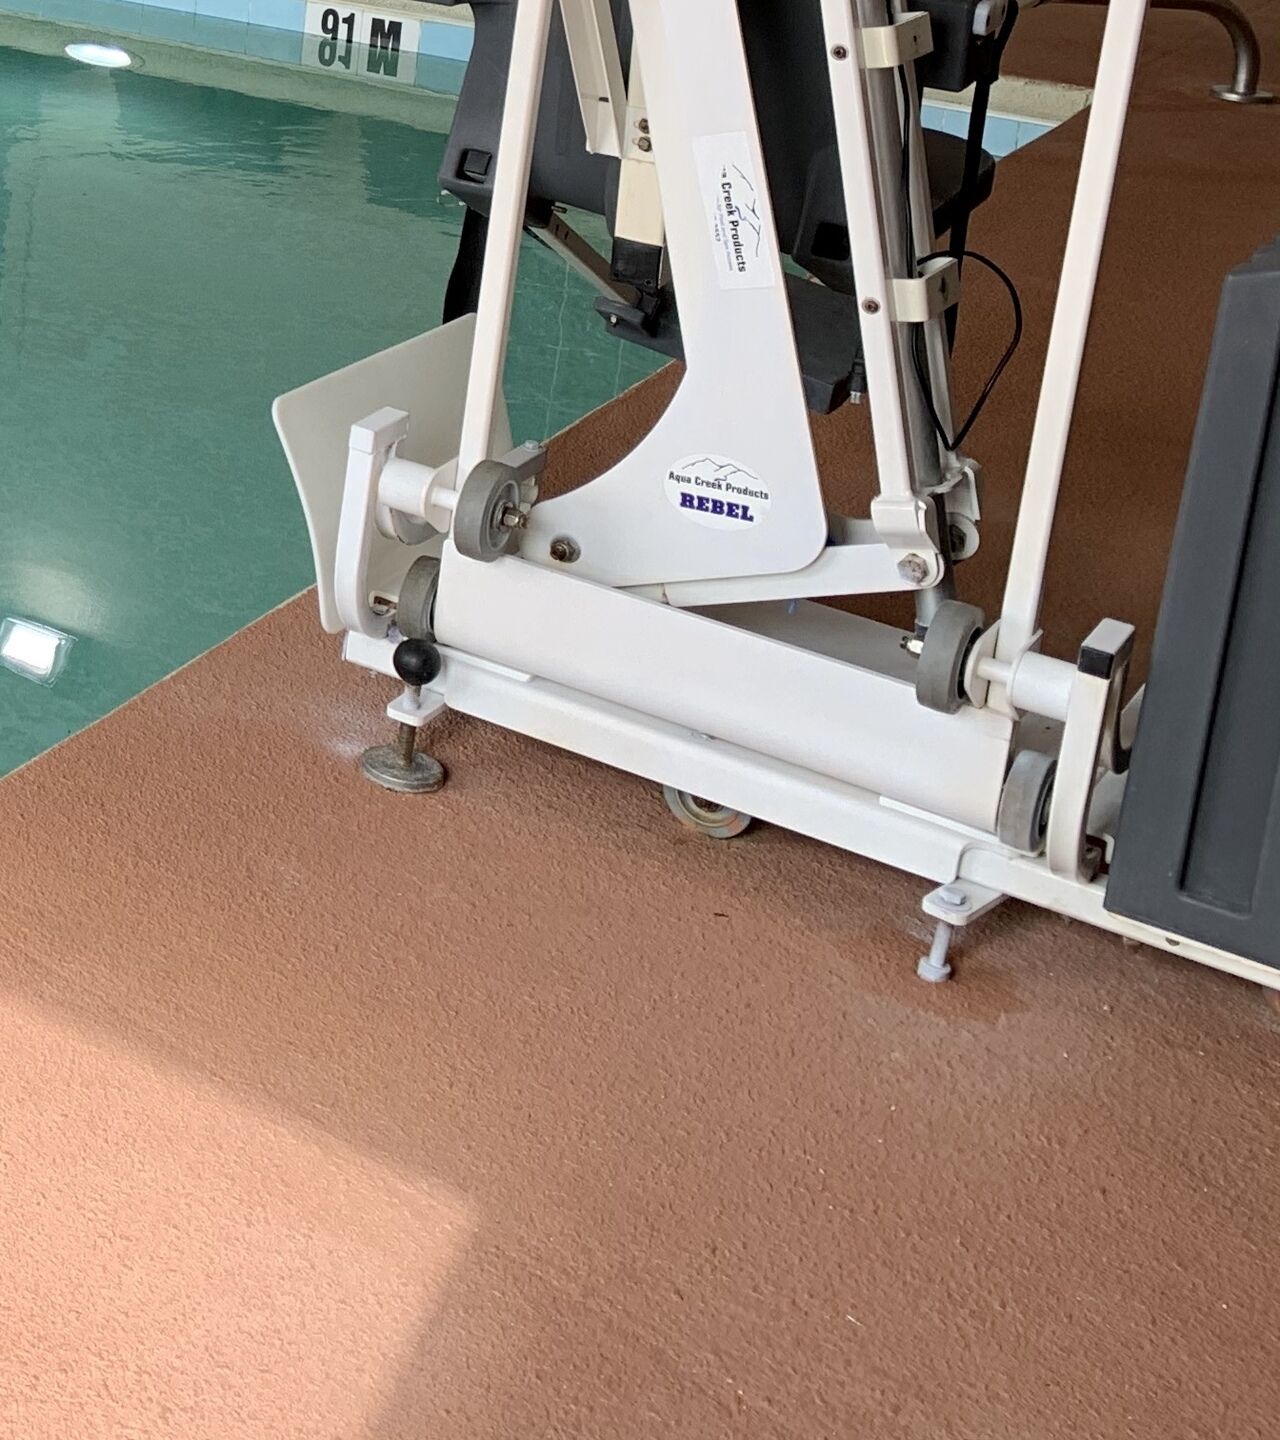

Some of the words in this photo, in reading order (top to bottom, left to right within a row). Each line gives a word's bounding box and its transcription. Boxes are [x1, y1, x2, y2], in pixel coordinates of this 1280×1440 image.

[369, 17, 403, 52] M
[721, 181, 737, 217] Creek
[729, 220, 747, 273] Products
[668, 471, 692, 484] Aqua
[694, 476, 723, 491] Creek
[725, 483, 770, 500] Products
[680, 491, 755, 522] REBEL
